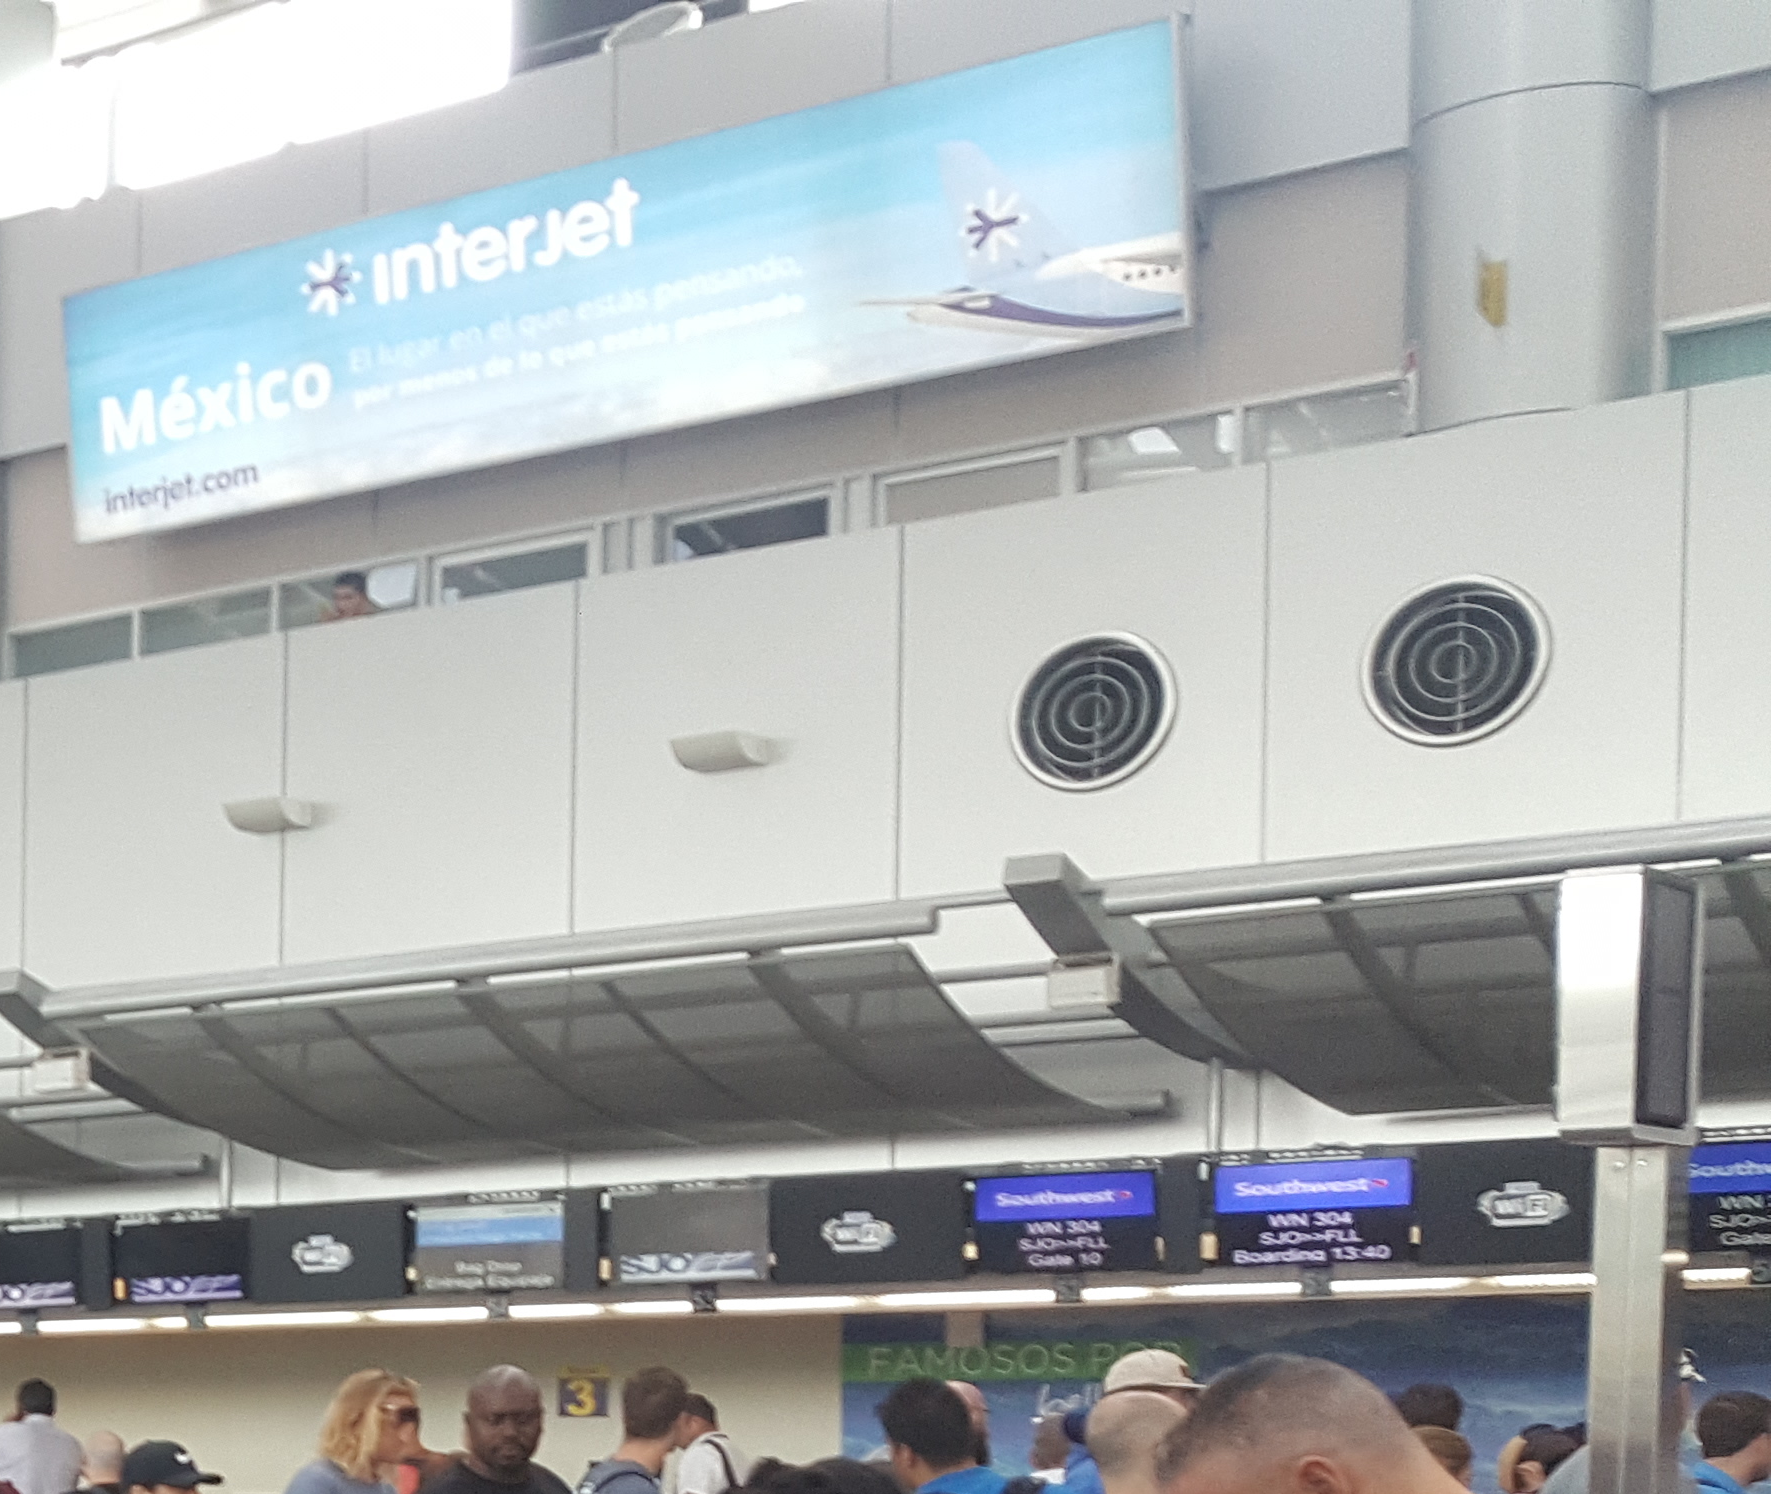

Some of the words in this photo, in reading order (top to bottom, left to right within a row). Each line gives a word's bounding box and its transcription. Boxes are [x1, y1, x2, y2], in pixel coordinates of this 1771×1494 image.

[99, 361, 332, 455] México
[104, 464, 259, 514] interjet.com
[1234, 1178, 1370, 1197] Southwest
[995, 1189, 1117, 1207] Southwest
[1025, 1221, 1064, 1236] WN
[1267, 1212, 1309, 1228] WN
[1028, 1253, 1075, 1267] Gate
[1232, 1248, 1328, 1265] Boarding
[868, 1343, 1076, 1377] FAMOSOS
[567, 1380, 596, 1417] 3
